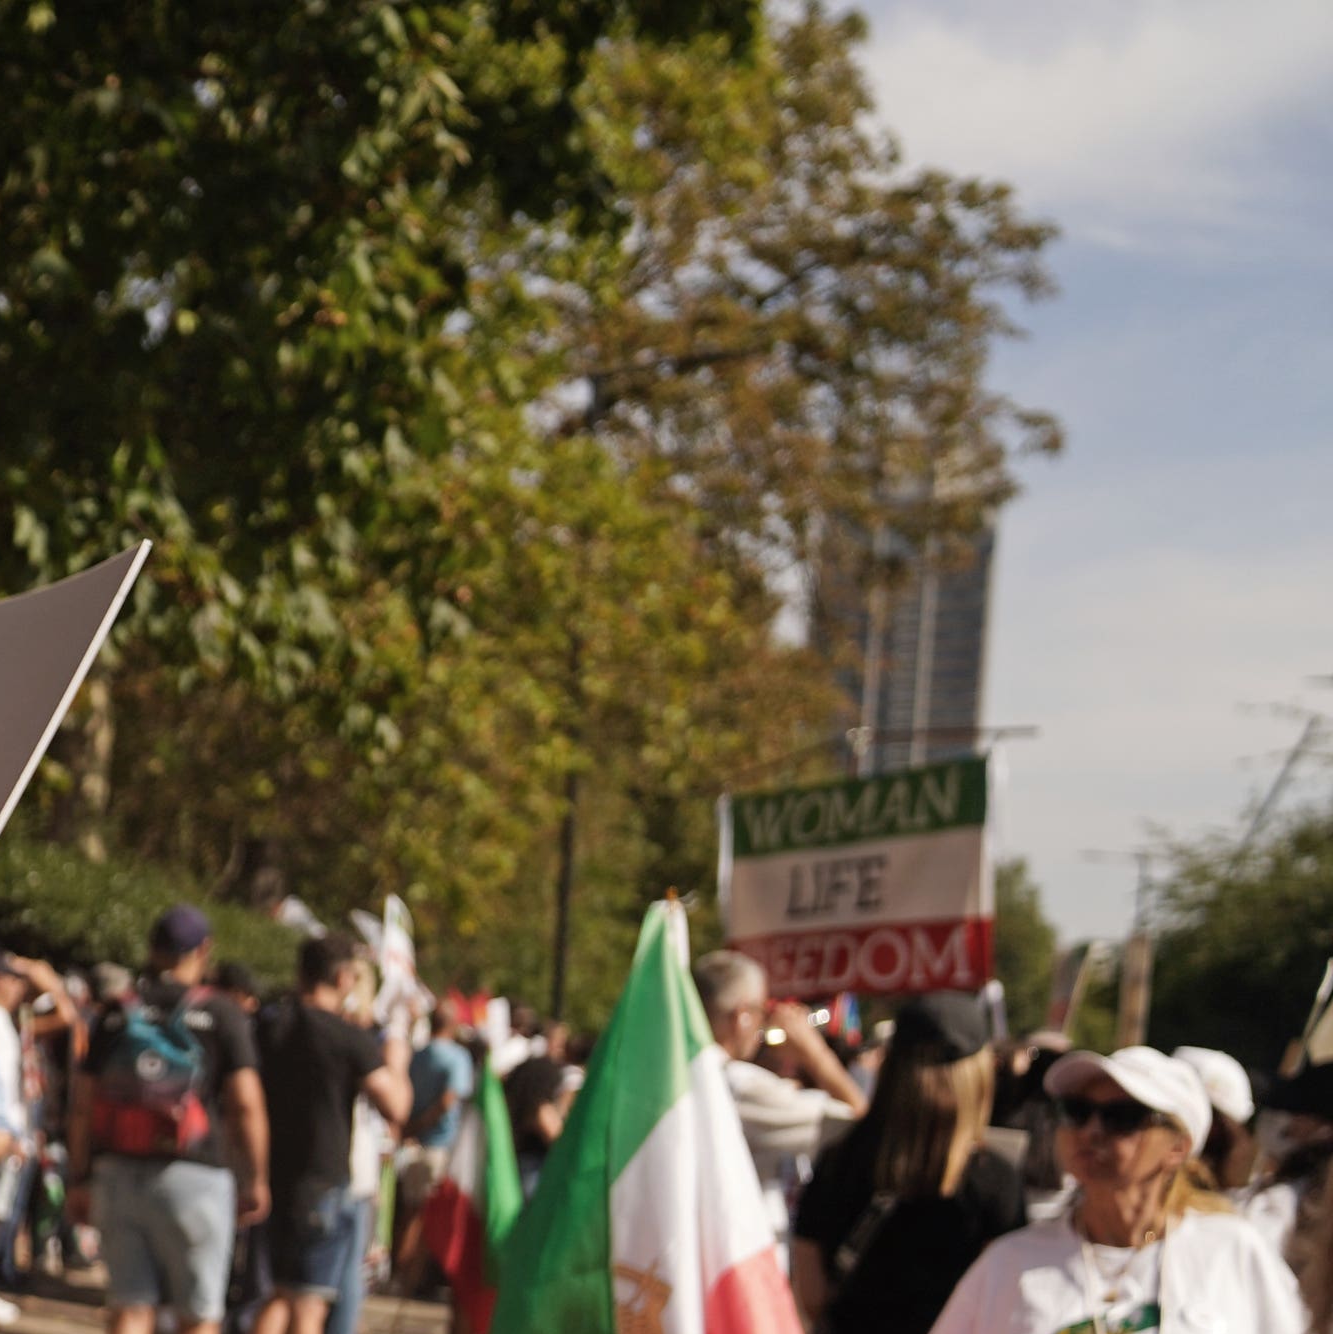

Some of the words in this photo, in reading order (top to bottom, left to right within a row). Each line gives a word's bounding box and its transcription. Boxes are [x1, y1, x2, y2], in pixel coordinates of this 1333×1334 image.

[742, 766, 961, 849] WOMAN
[787, 855, 886, 918] LIFE
[741, 925, 976, 995] EEDOM
